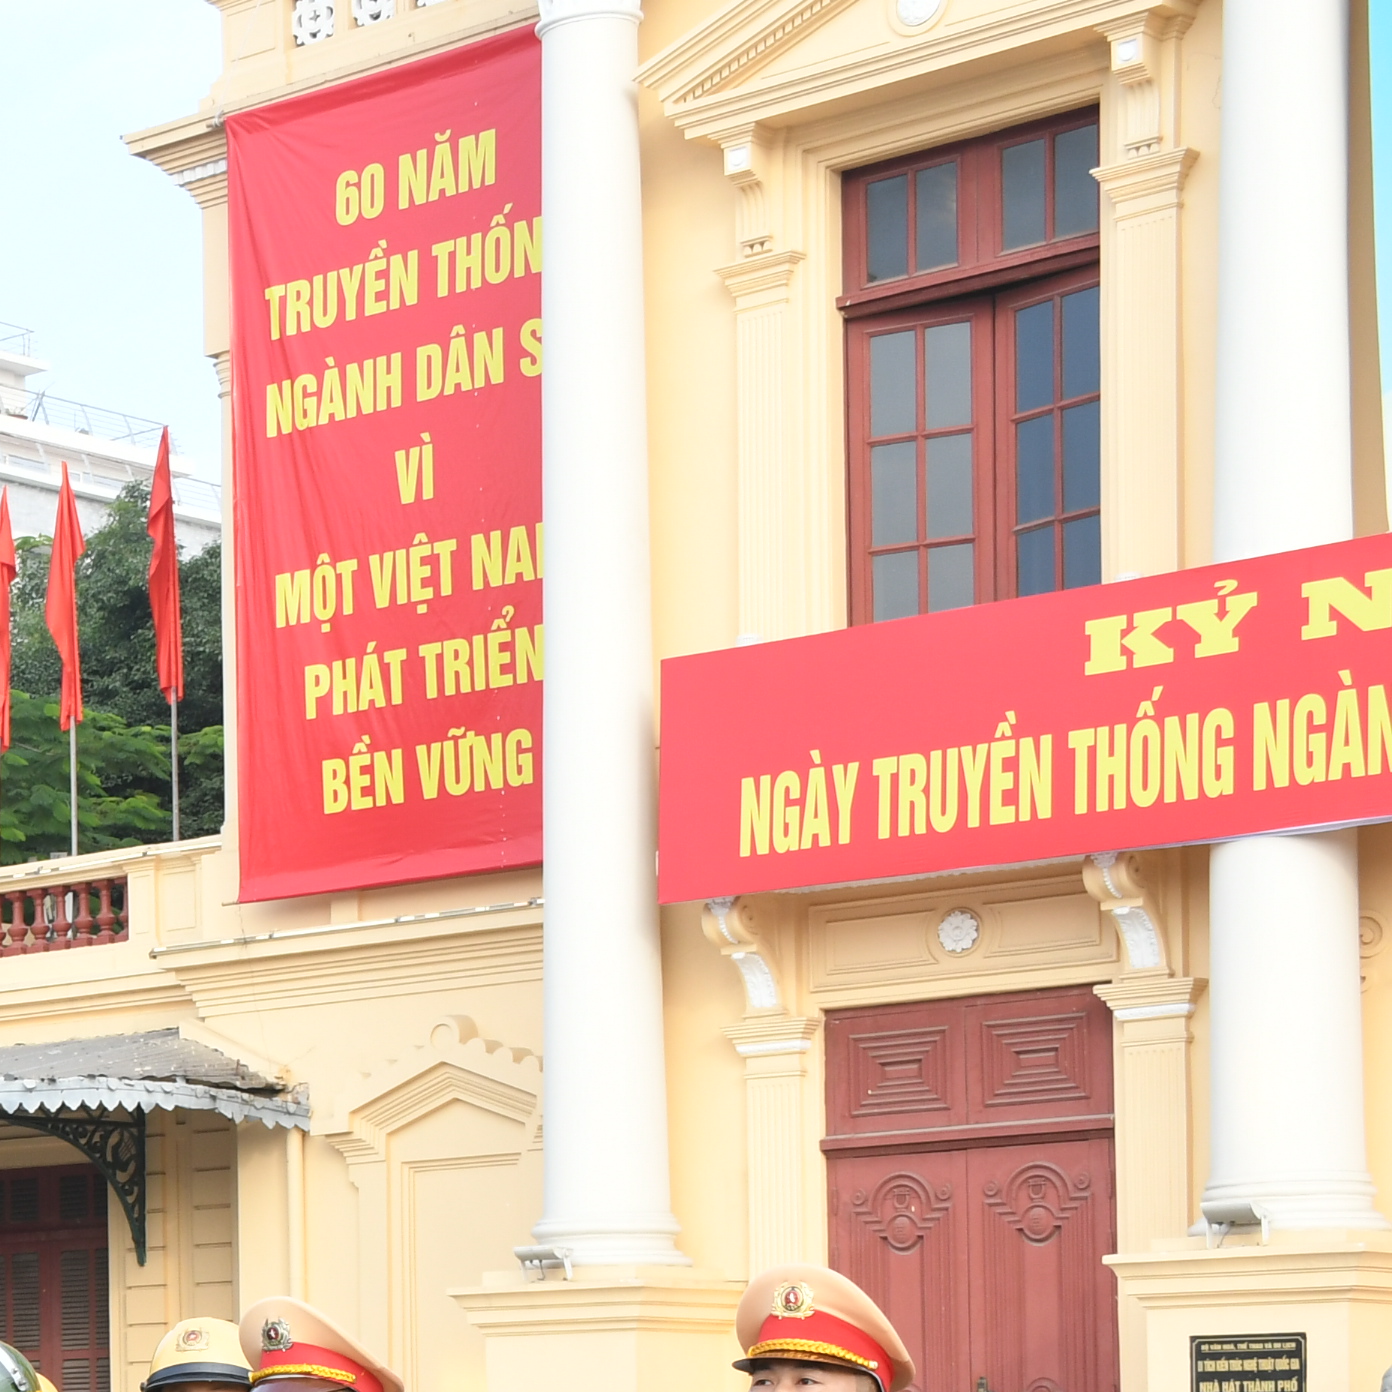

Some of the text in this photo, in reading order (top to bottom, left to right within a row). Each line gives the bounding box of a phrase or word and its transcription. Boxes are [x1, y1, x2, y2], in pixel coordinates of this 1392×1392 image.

[335, 128, 497, 226] 60 NĂM
[264, 202, 543, 342] TRUYỀN THỐN
[266, 317, 543, 439] NGÀNH DÂN S
[394, 432, 435, 505] VÌ
[274, 552, 359, 633] MỘT
[368, 531, 458, 614] VIỆT
[1084, 578, 1259, 676] KỶ
[304, 605, 544, 720] PHÁT TRIỂN
[321, 726, 535, 815] BỀN VỮNG
[738, 750, 860, 858] NGÀY
[872, 710, 1053, 840] TRUYỀN
[1068, 686, 1236, 816] THỐNG
